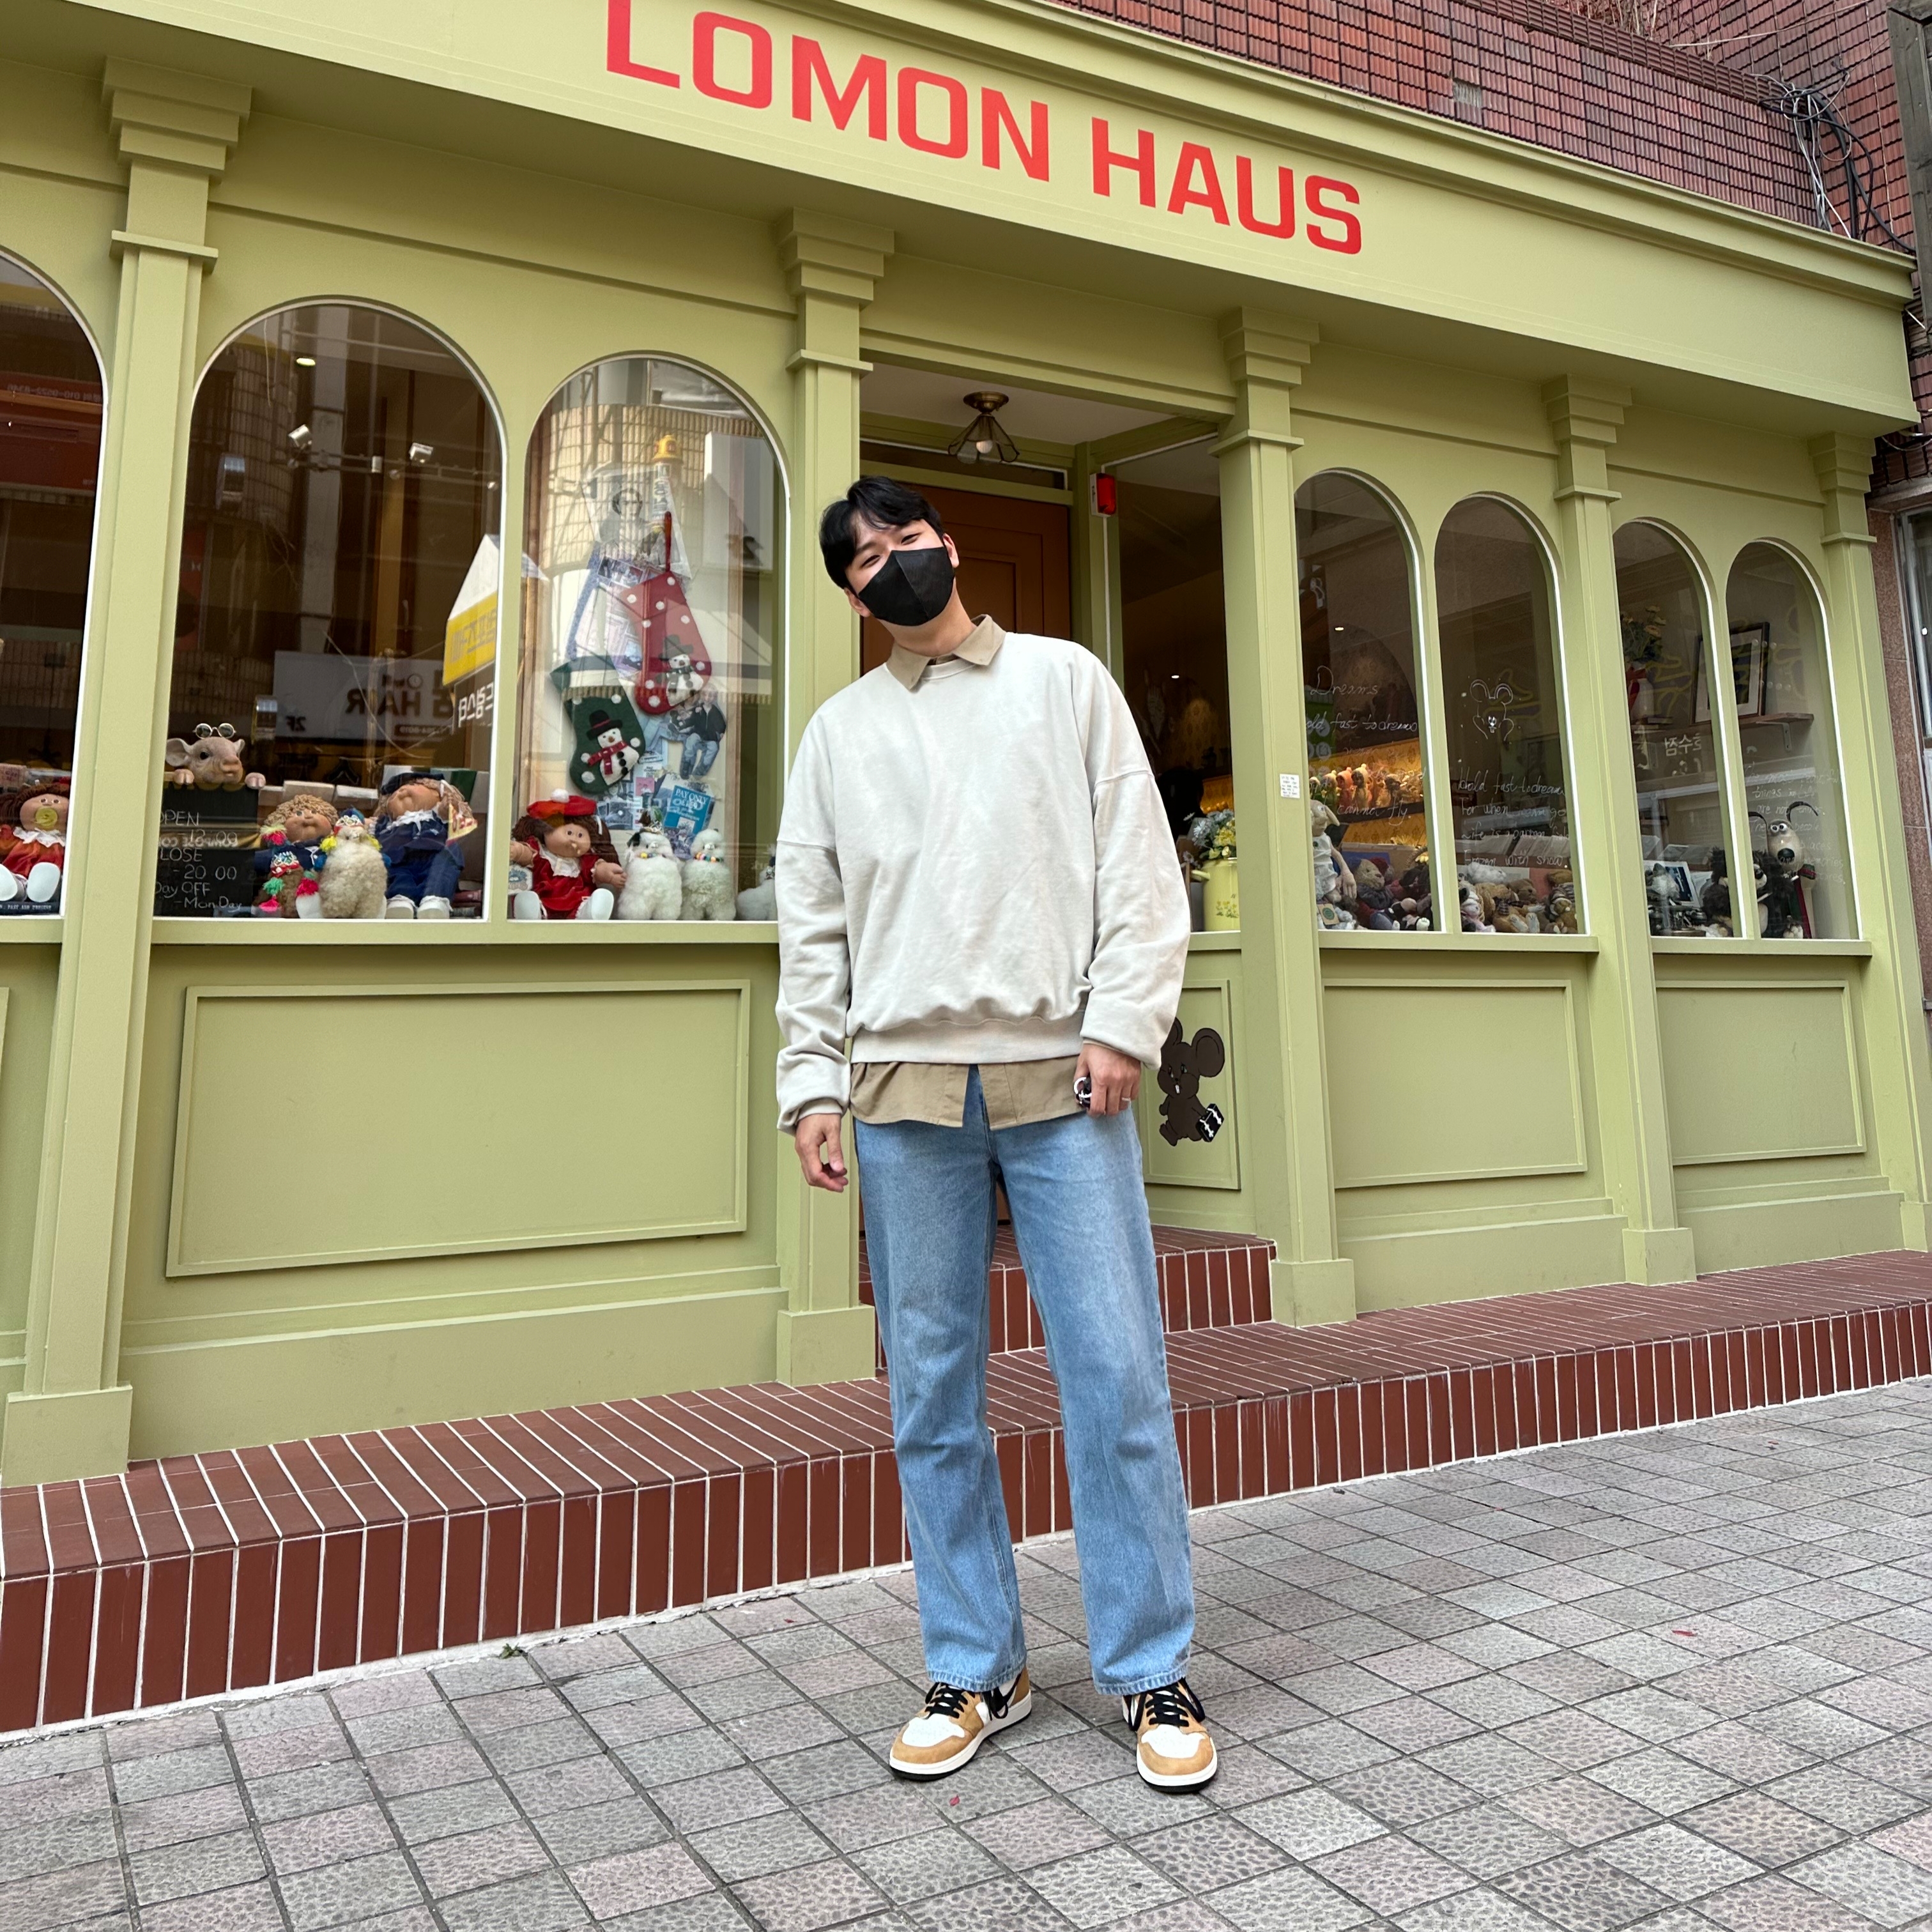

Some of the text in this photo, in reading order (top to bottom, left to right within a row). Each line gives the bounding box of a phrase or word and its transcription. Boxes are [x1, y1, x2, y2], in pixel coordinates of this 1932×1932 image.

[606, 0, 1361, 254] LOMON HAUS
[1310, 665, 1378, 695] Dreams
[1307, 711, 1326, 730] old
[1330, 712, 1358, 733] fast
[1458, 767, 1489, 792] Hold
[1492, 772, 1518, 794] fast
[675, 788, 689, 799] PAY
[158, 847, 203, 862] LOSE
[1505, 850, 1529, 867] with
[181, 882, 211, 896] OFF
